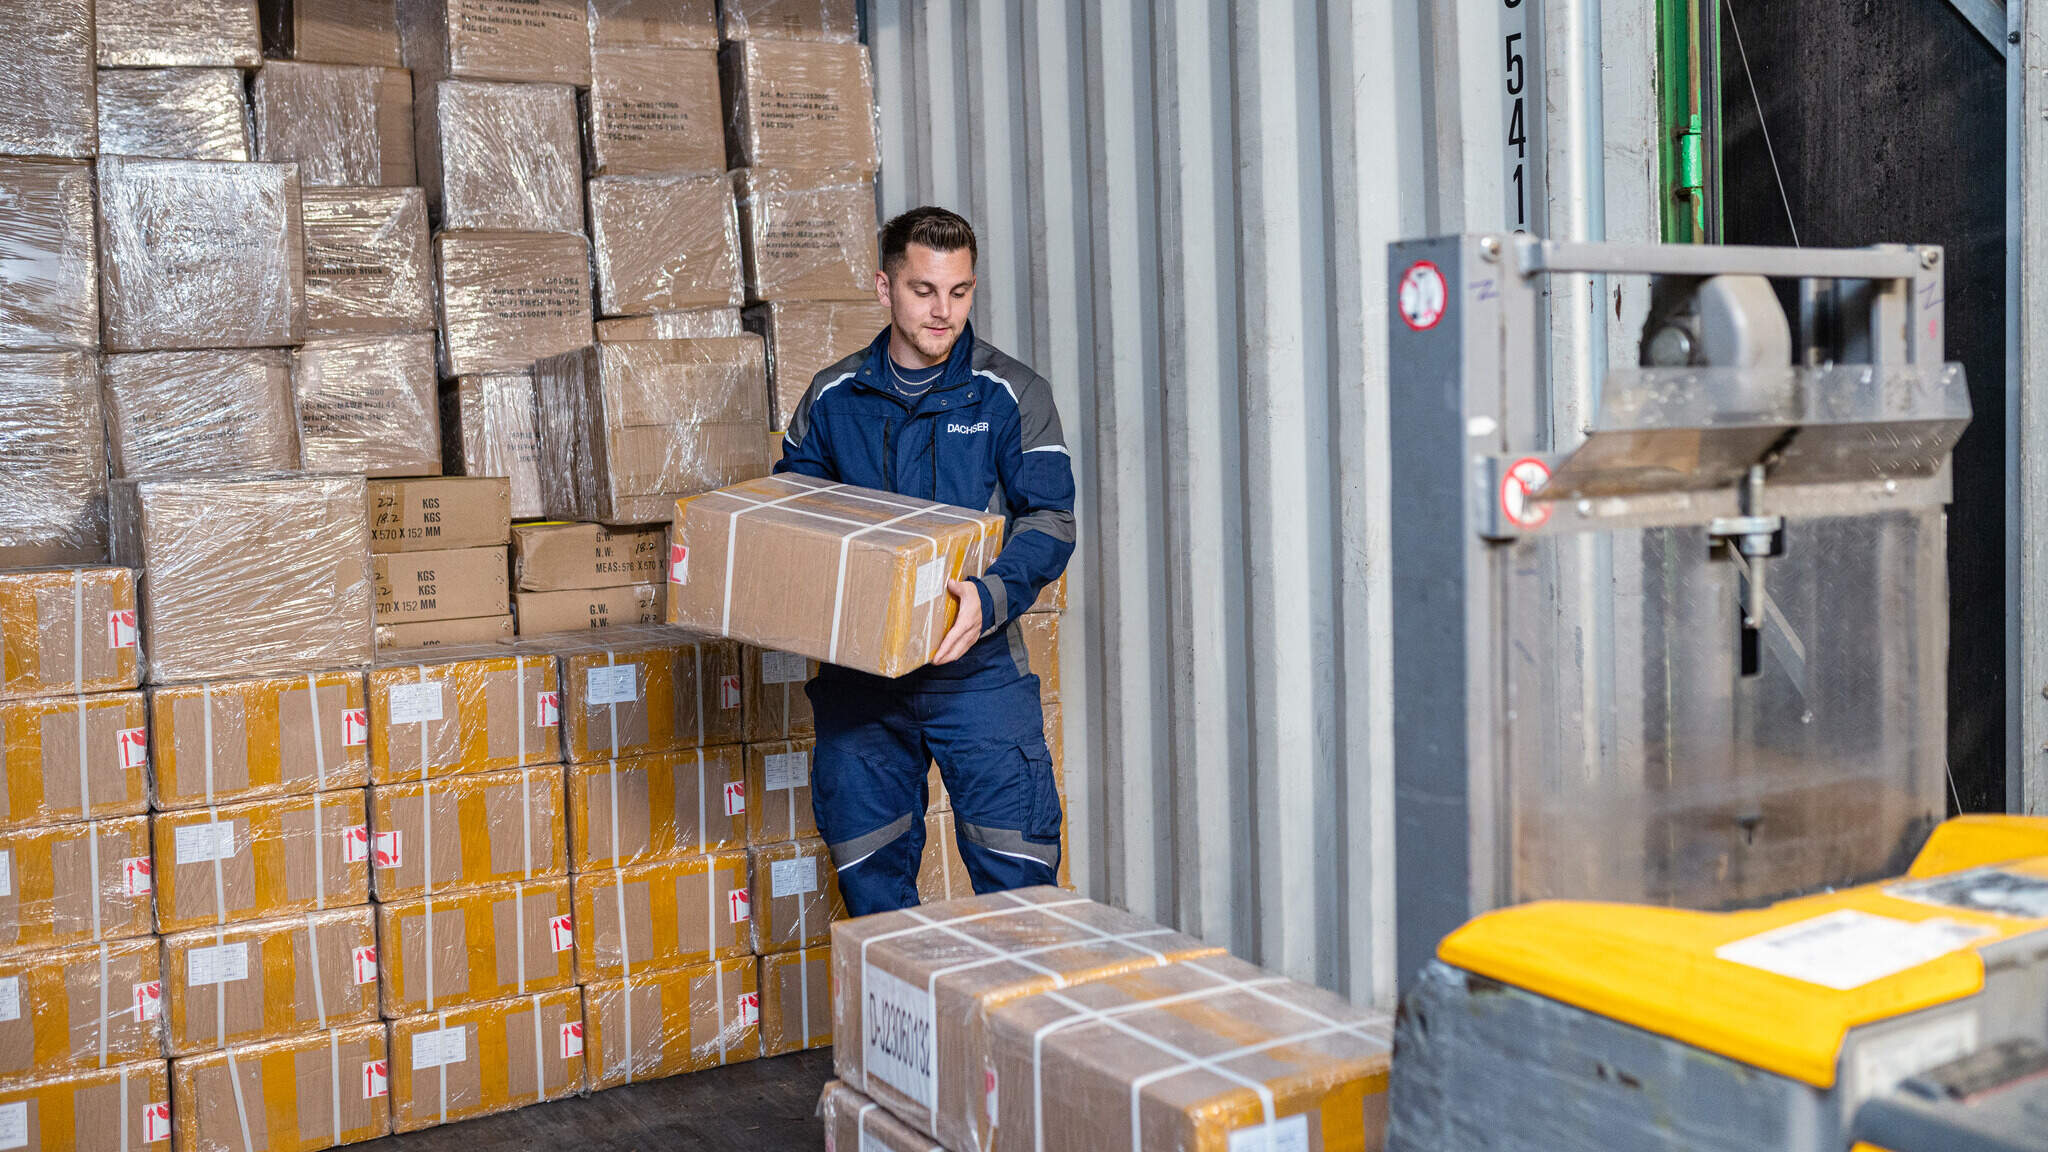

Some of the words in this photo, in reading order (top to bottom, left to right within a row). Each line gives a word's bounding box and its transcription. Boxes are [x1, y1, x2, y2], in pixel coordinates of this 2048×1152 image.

[947, 422, 989, 435] DACHSER
[422, 498, 440, 509] KGS
[424, 512, 441, 523] KGS
[379, 529, 397, 540] 570
[399, 528, 406, 538] X
[408, 528, 423, 539] 152
[425, 526, 441, 537] MM
[417, 571, 435, 581] KGS
[418, 585, 437, 596] KGS
[393, 601, 399, 611] X
[402, 601, 418, 612] 152
[420, 599, 436, 610] MM
